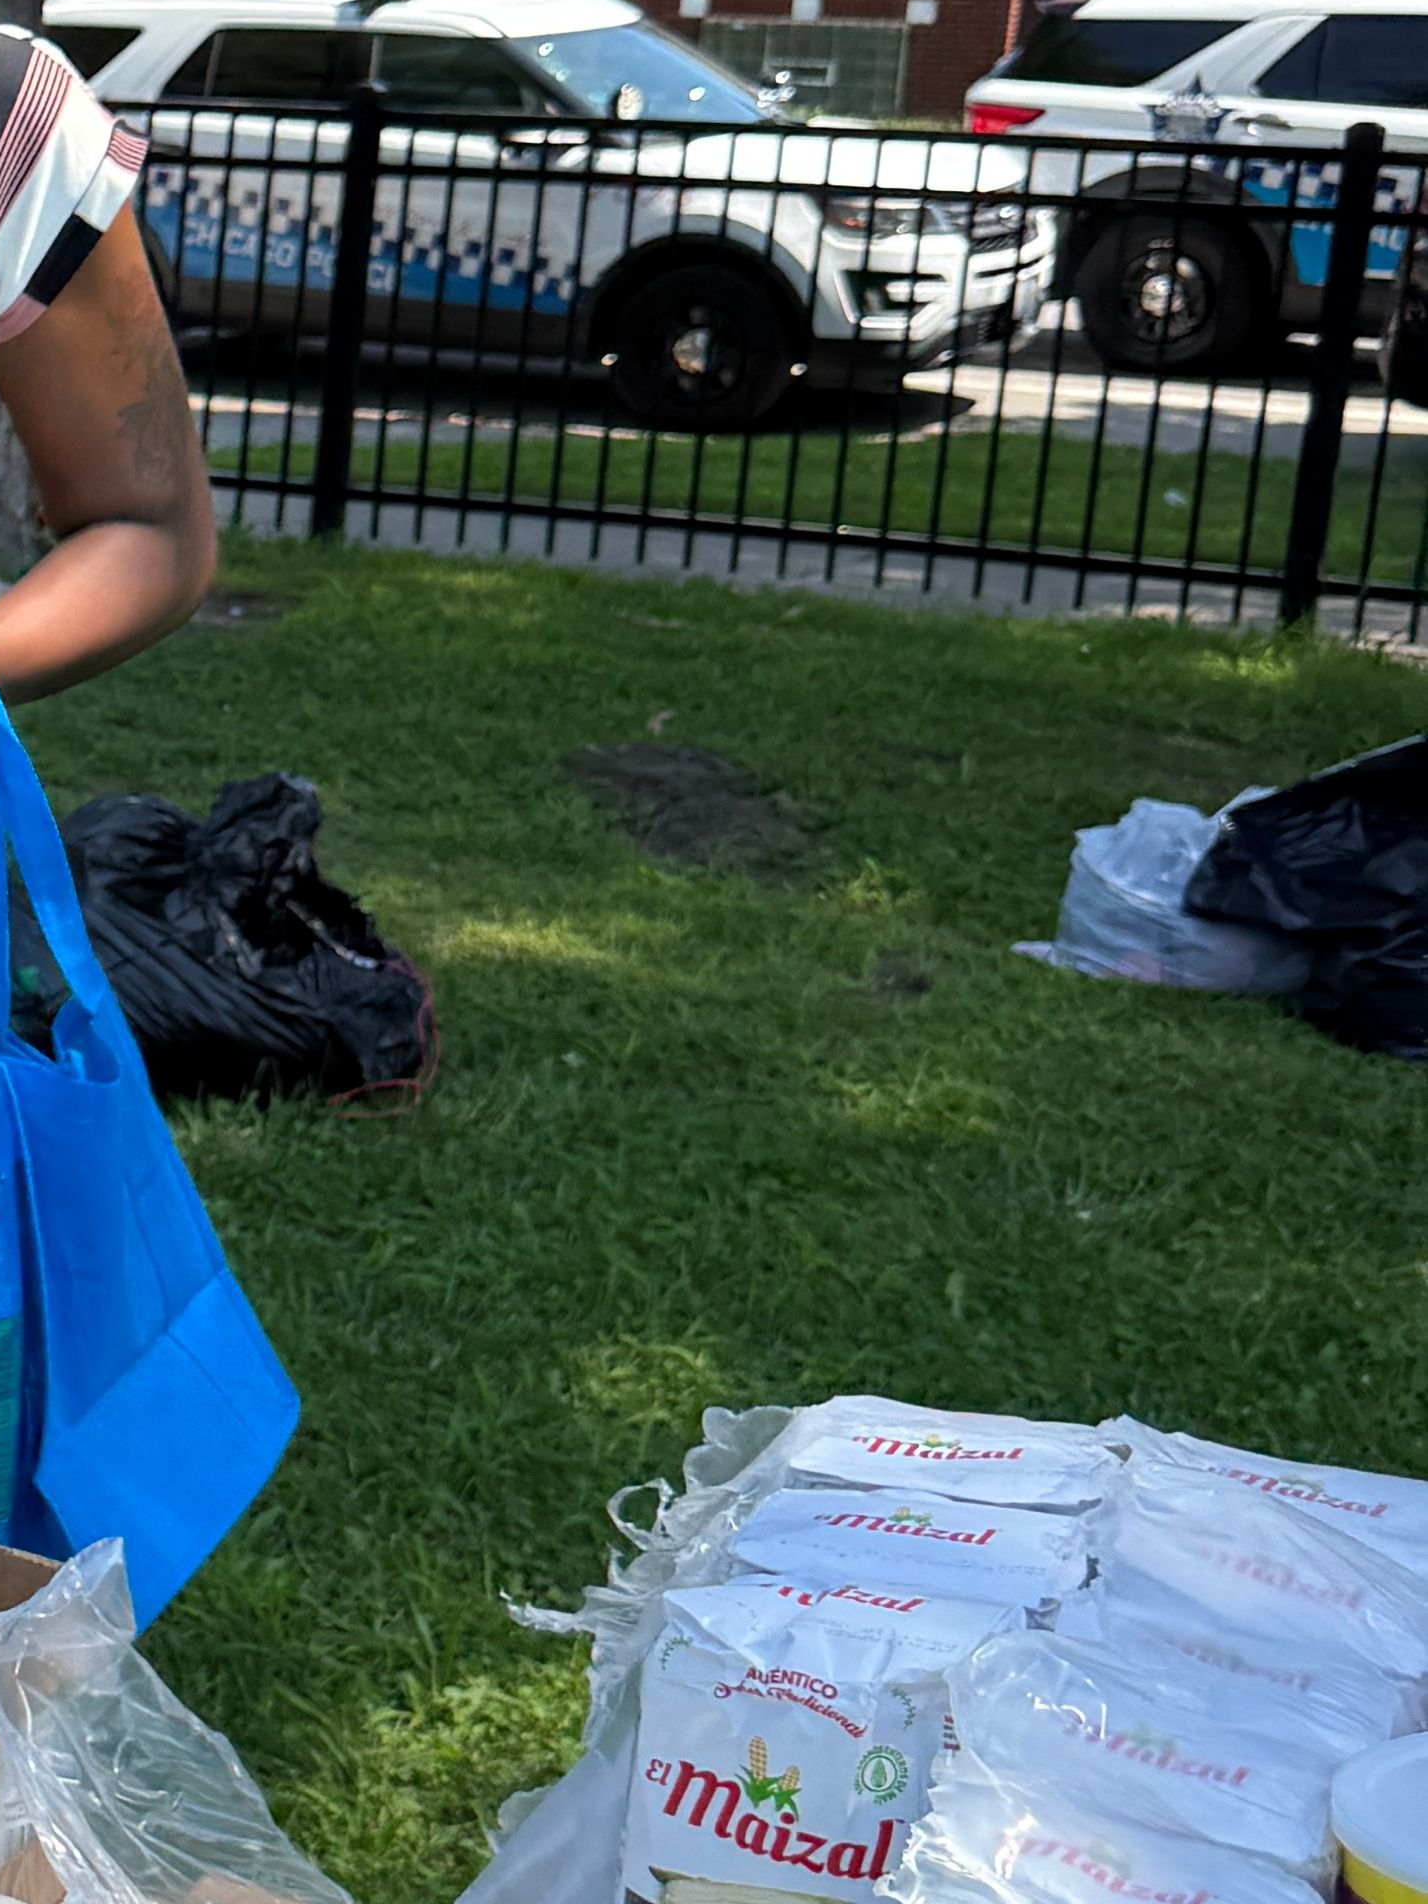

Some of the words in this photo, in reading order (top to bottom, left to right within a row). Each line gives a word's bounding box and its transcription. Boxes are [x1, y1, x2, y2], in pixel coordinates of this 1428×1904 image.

[865, 1436, 1025, 1460] Maizal
[827, 1513, 998, 1545] Maizal
[645, 1758, 672, 1786] El
[663, 1760, 896, 1882] Maizal
